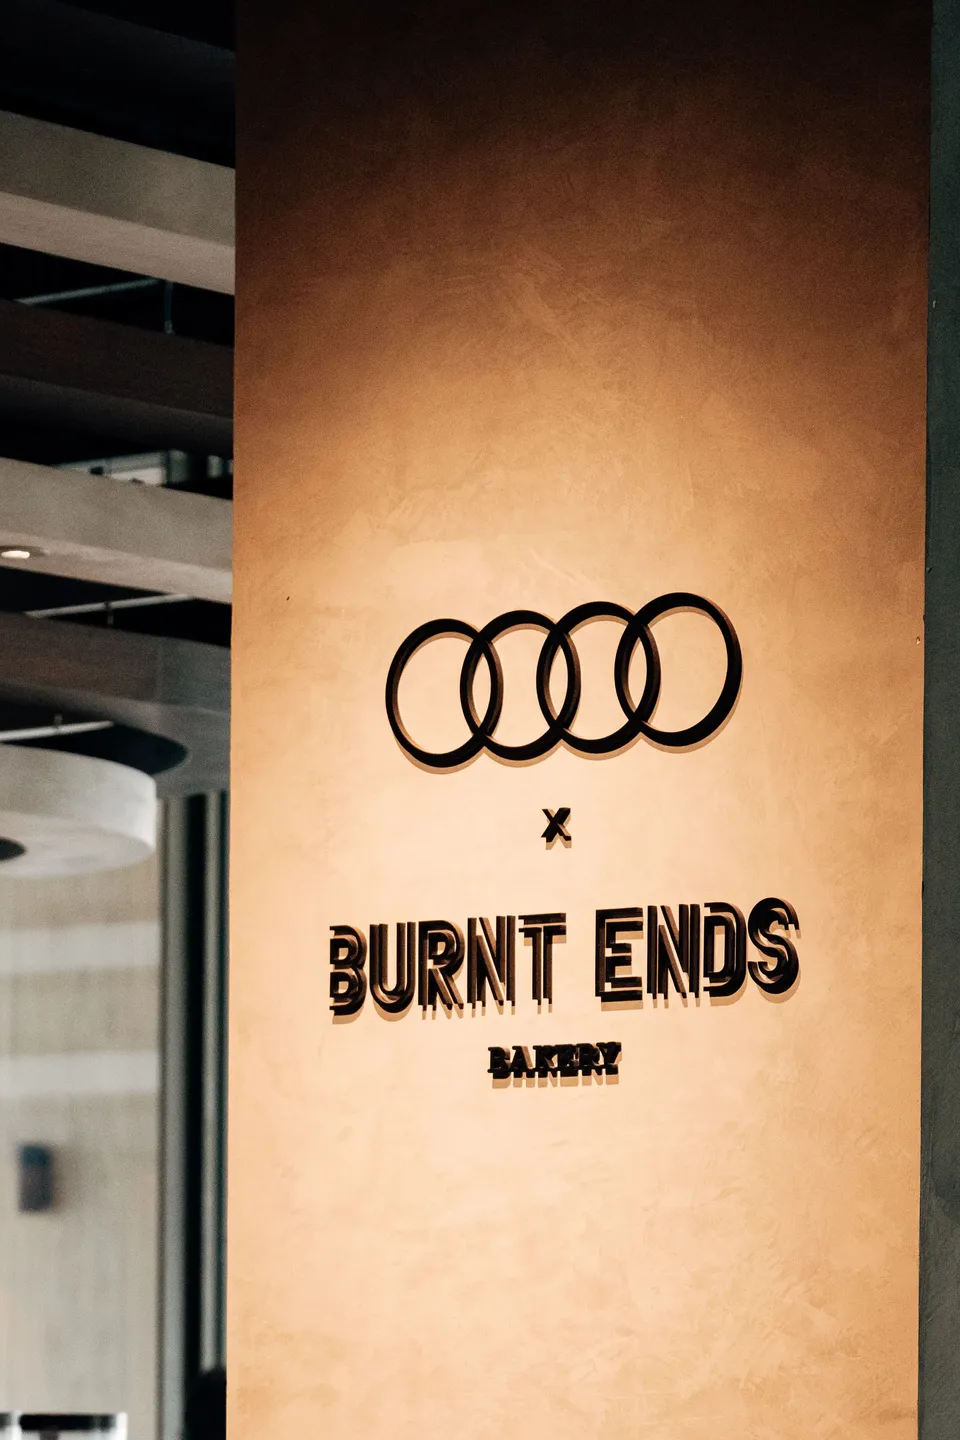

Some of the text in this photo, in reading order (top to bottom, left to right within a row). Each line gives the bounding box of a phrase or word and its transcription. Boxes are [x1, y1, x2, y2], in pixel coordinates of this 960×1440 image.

[329, 897, 801, 1017] BURNT ENDS
[487, 1041, 622, 1079] BAKERY
